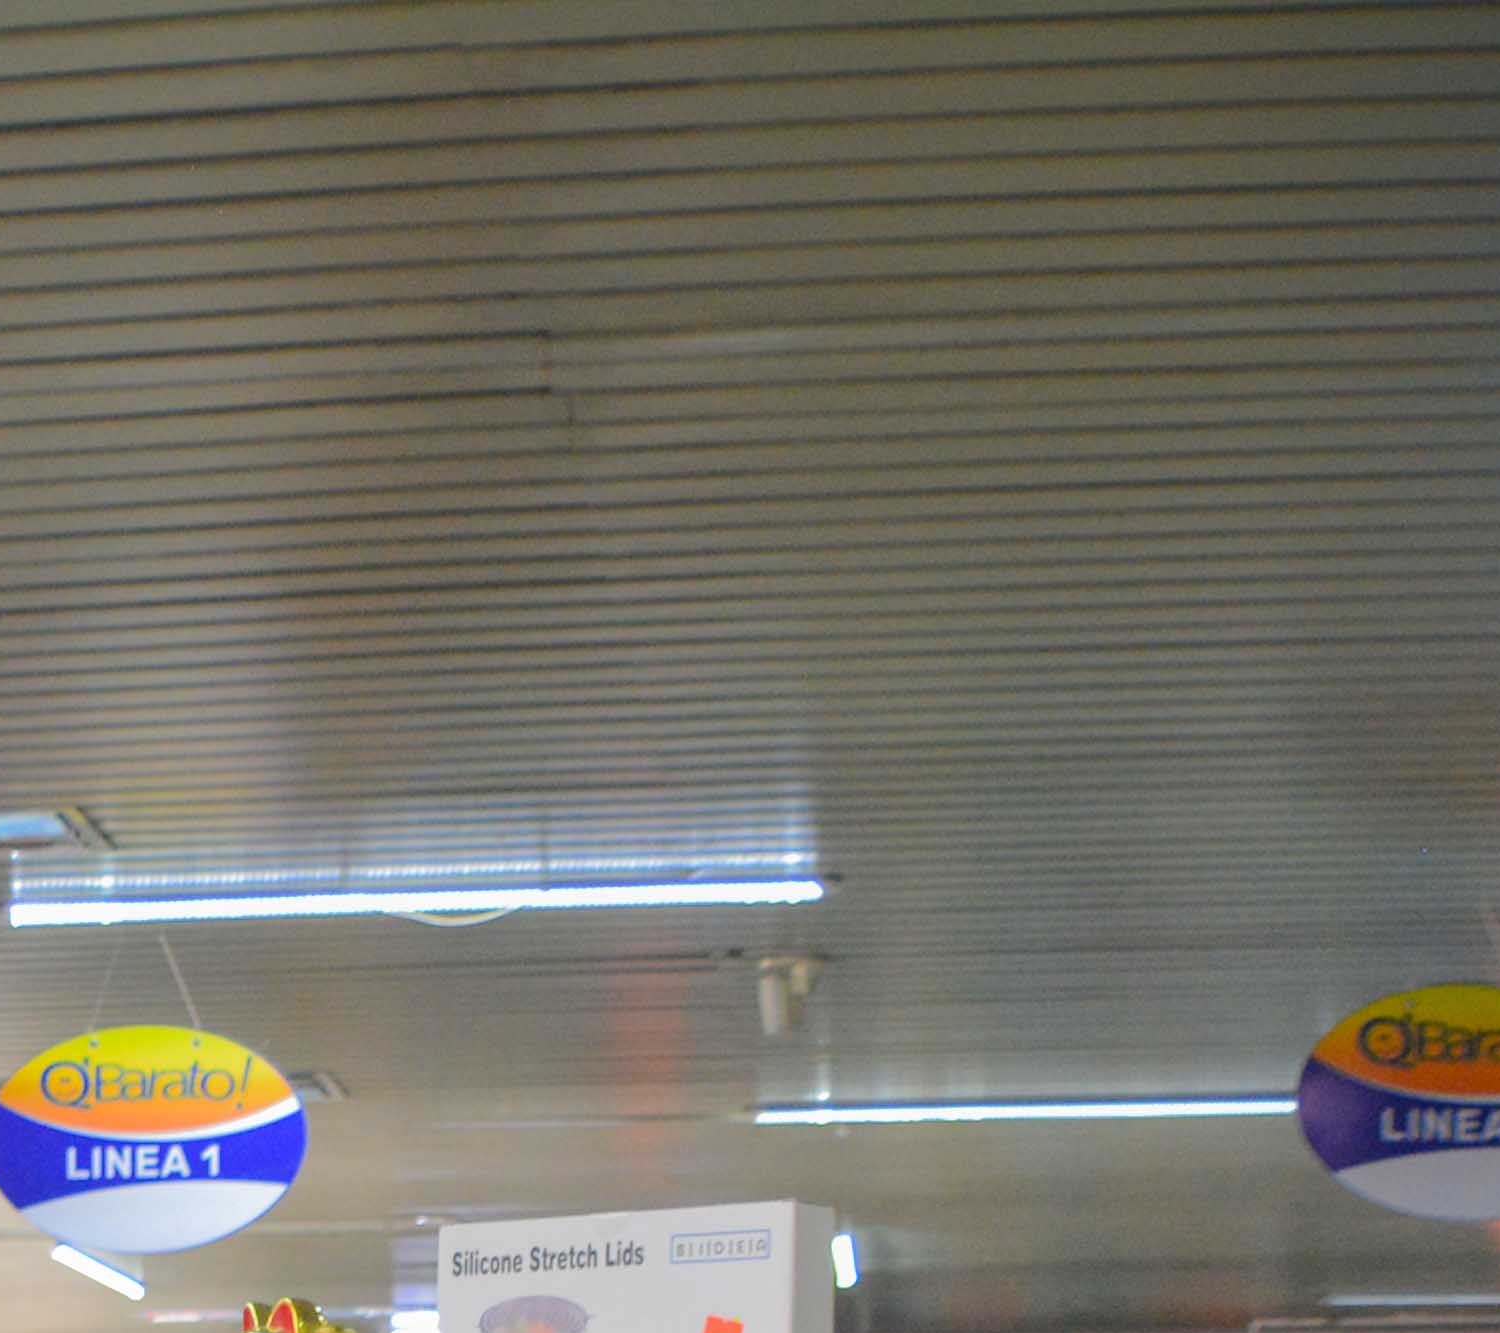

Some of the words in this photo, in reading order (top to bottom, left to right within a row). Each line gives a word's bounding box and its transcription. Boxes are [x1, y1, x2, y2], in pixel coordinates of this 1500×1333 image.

[66, 1145, 190, 1181] LINEA
[202, 1144, 222, 1178] 1
[452, 1248, 523, 1278] Silicone
[529, 1243, 598, 1273] Stretch
[605, 1239, 645, 1268] Lids
